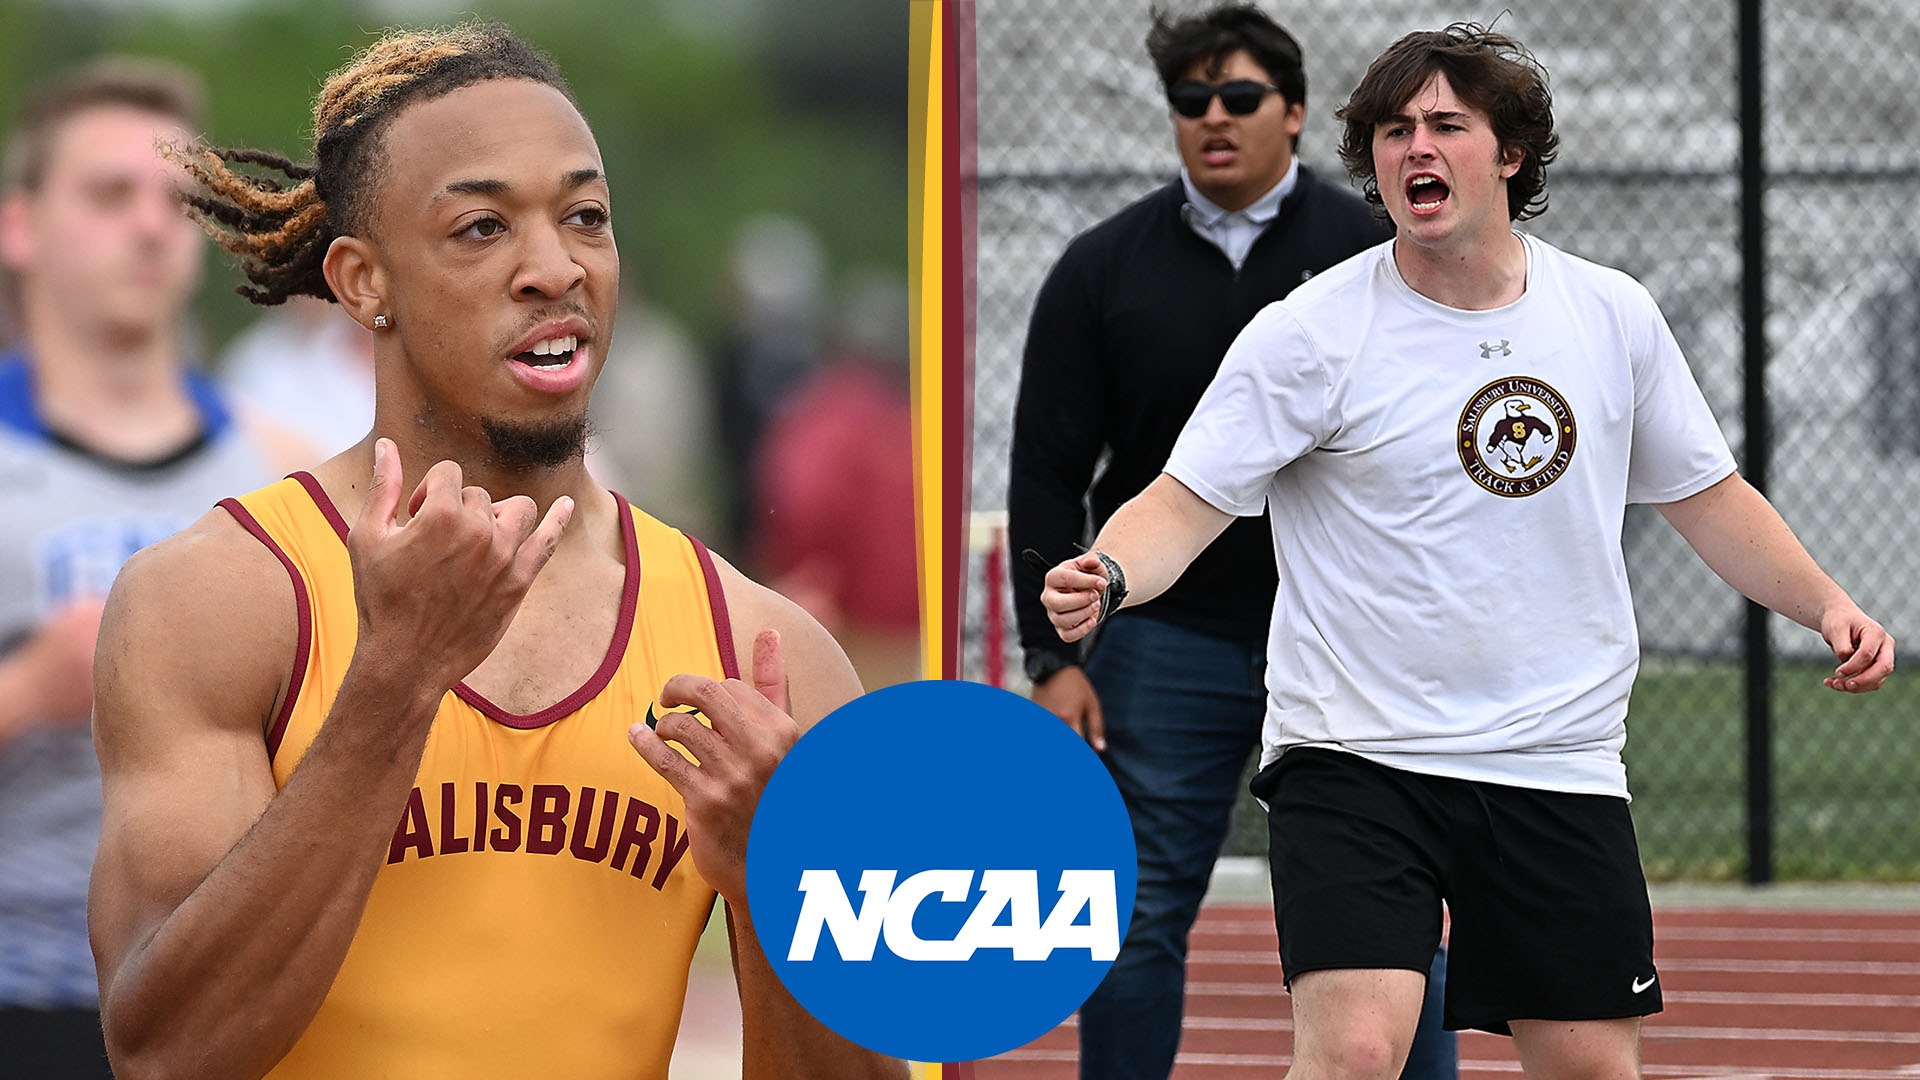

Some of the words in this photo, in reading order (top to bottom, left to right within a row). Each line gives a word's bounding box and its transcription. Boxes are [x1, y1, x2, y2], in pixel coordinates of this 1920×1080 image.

[1462, 385, 1506, 433] SALISBURY
[1508, 380, 1568, 420] UNIVERSITY
[1512, 421, 1527, 439] S
[1469, 458, 1514, 493] TRACK
[1519, 481, 1531, 493] &
[1534, 450, 1569, 488] FIELD
[387, 781, 690, 892] ALISBURY
